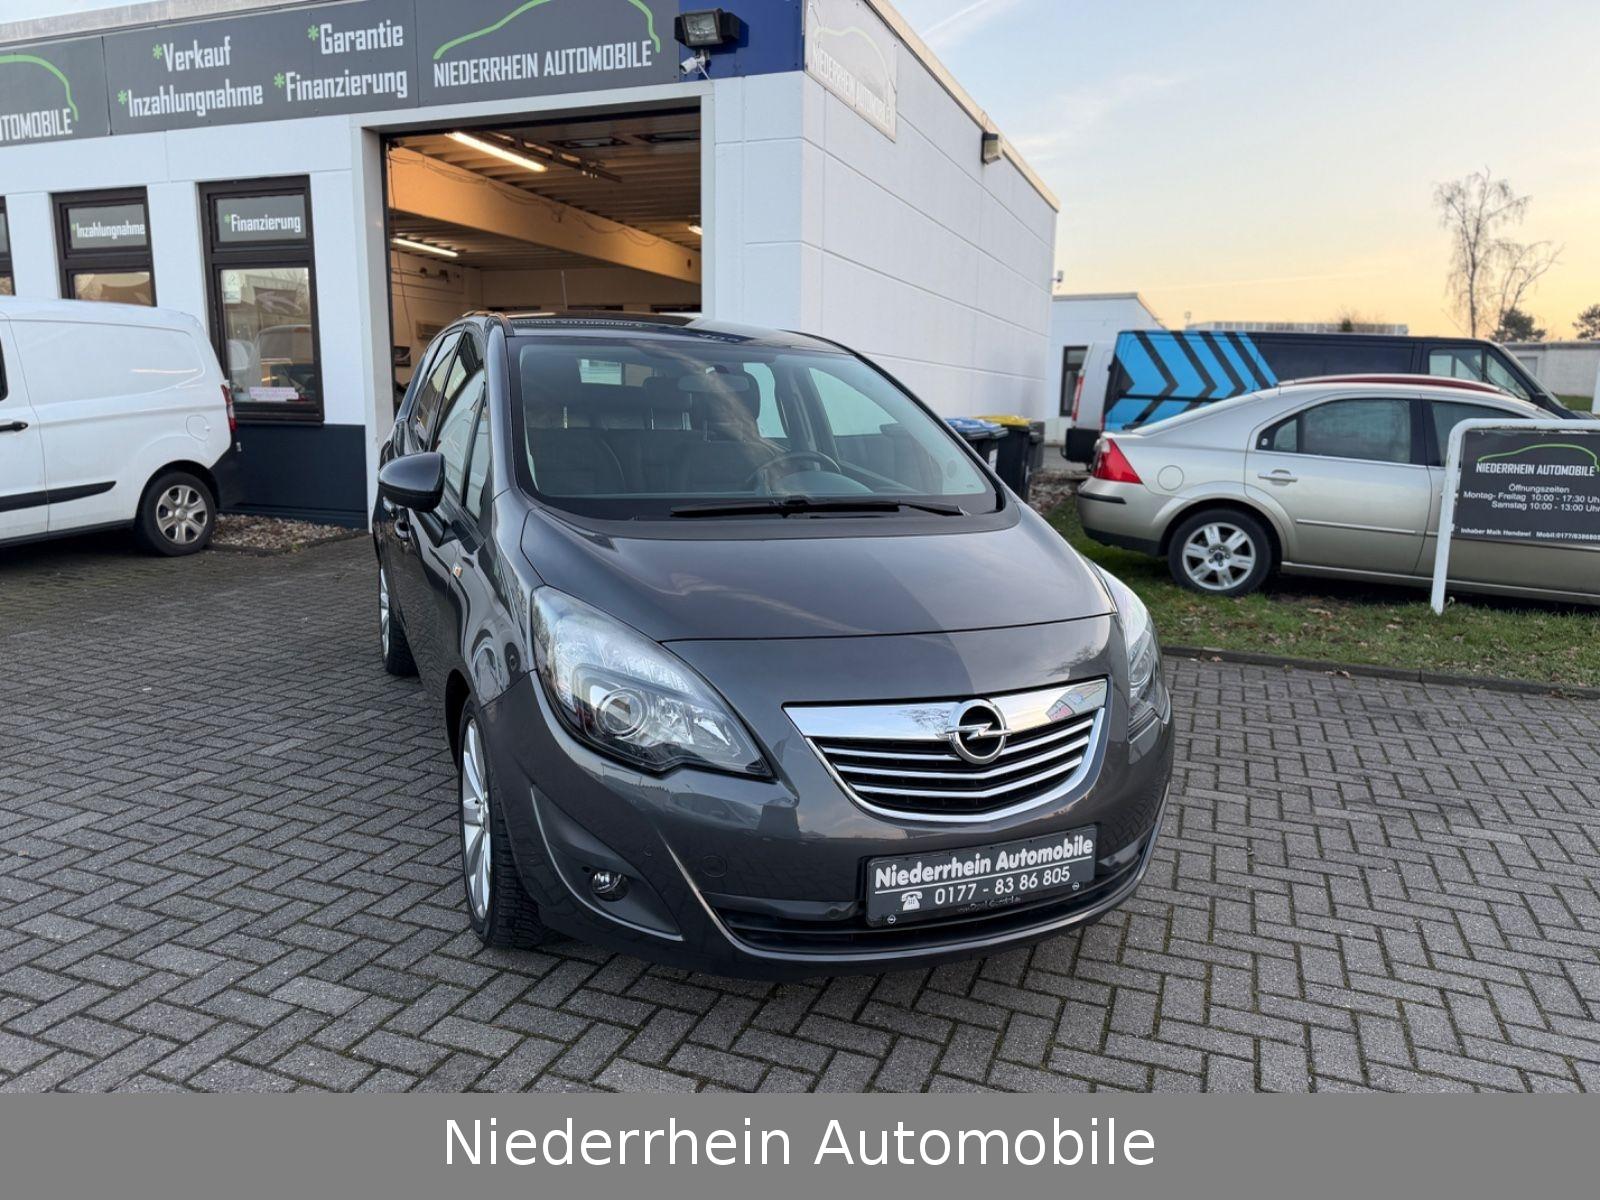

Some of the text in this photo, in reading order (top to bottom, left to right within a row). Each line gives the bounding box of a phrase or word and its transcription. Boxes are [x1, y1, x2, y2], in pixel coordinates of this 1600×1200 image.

[162, 35, 232, 73] Verkauf
[319, 19, 403, 55] Garantie
[433, 40, 653, 88] NIEDERRHEIN AUTOMOBILE
[128, 78, 264, 118] Inzahlungnahme
[285, 69, 408, 102] Finanzierung
[76, 220, 146, 240] Inzahlungnahme
[230, 213, 302, 233] Finanzierung
[1476, 462, 1595, 477] NIEDERRHEIN AUTOMOBILE
[1491, 500, 1527, 511] Samstag
[1530, 502, 1553, 510] 10:00
[1561, 503, 1584, 511] 13:00
[1498, 491, 1526, 502] Freitag
[1531, 493, 1554, 502] 10:00
[1562, 494, 1585, 503] 17:30
[875, 834, 1093, 889] Niederrhein Automobile
[934, 883, 977, 905] 0177
[994, 877, 1014, 896] 83
[1019, 872, 1038, 891] 86
[1042, 866, 1071, 887] 805
